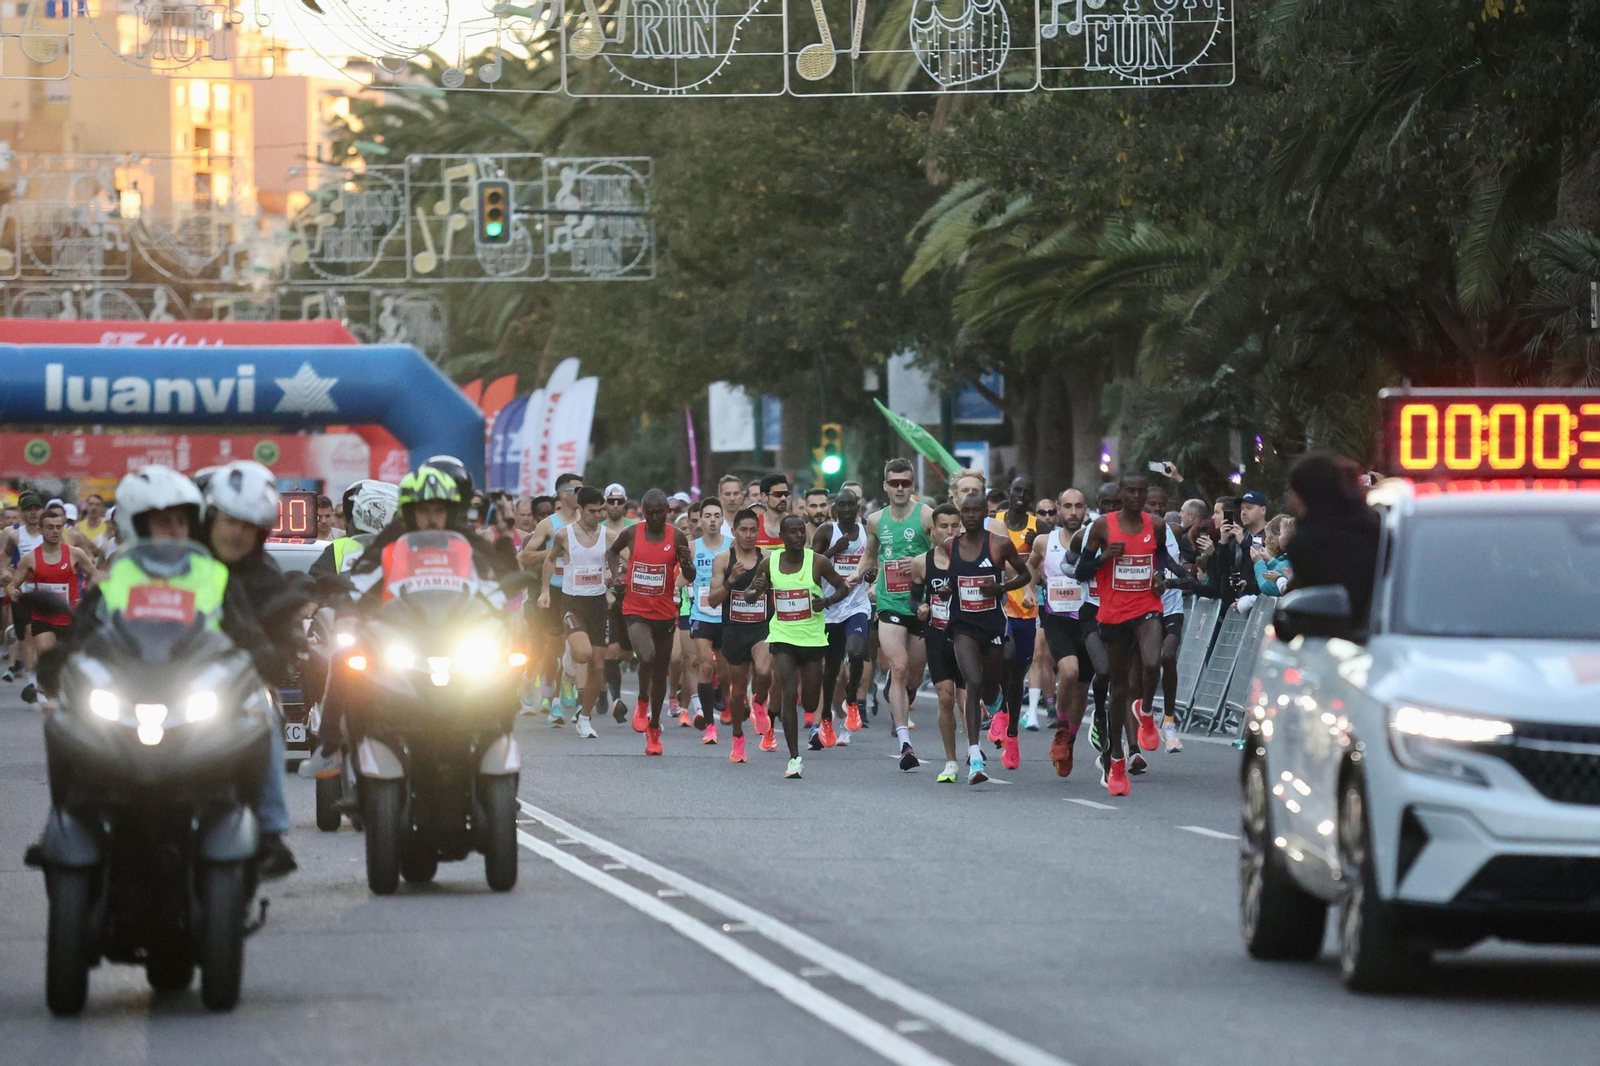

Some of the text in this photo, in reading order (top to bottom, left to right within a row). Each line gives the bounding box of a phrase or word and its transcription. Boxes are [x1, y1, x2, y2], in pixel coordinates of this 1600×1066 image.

[631, 0, 717, 59] RIN
[1083, 14, 1174, 73] FUN
[45, 363, 256, 414] luanvi
[634, 573, 663, 581] MBURUGU
[697, 558, 714, 567] ne
